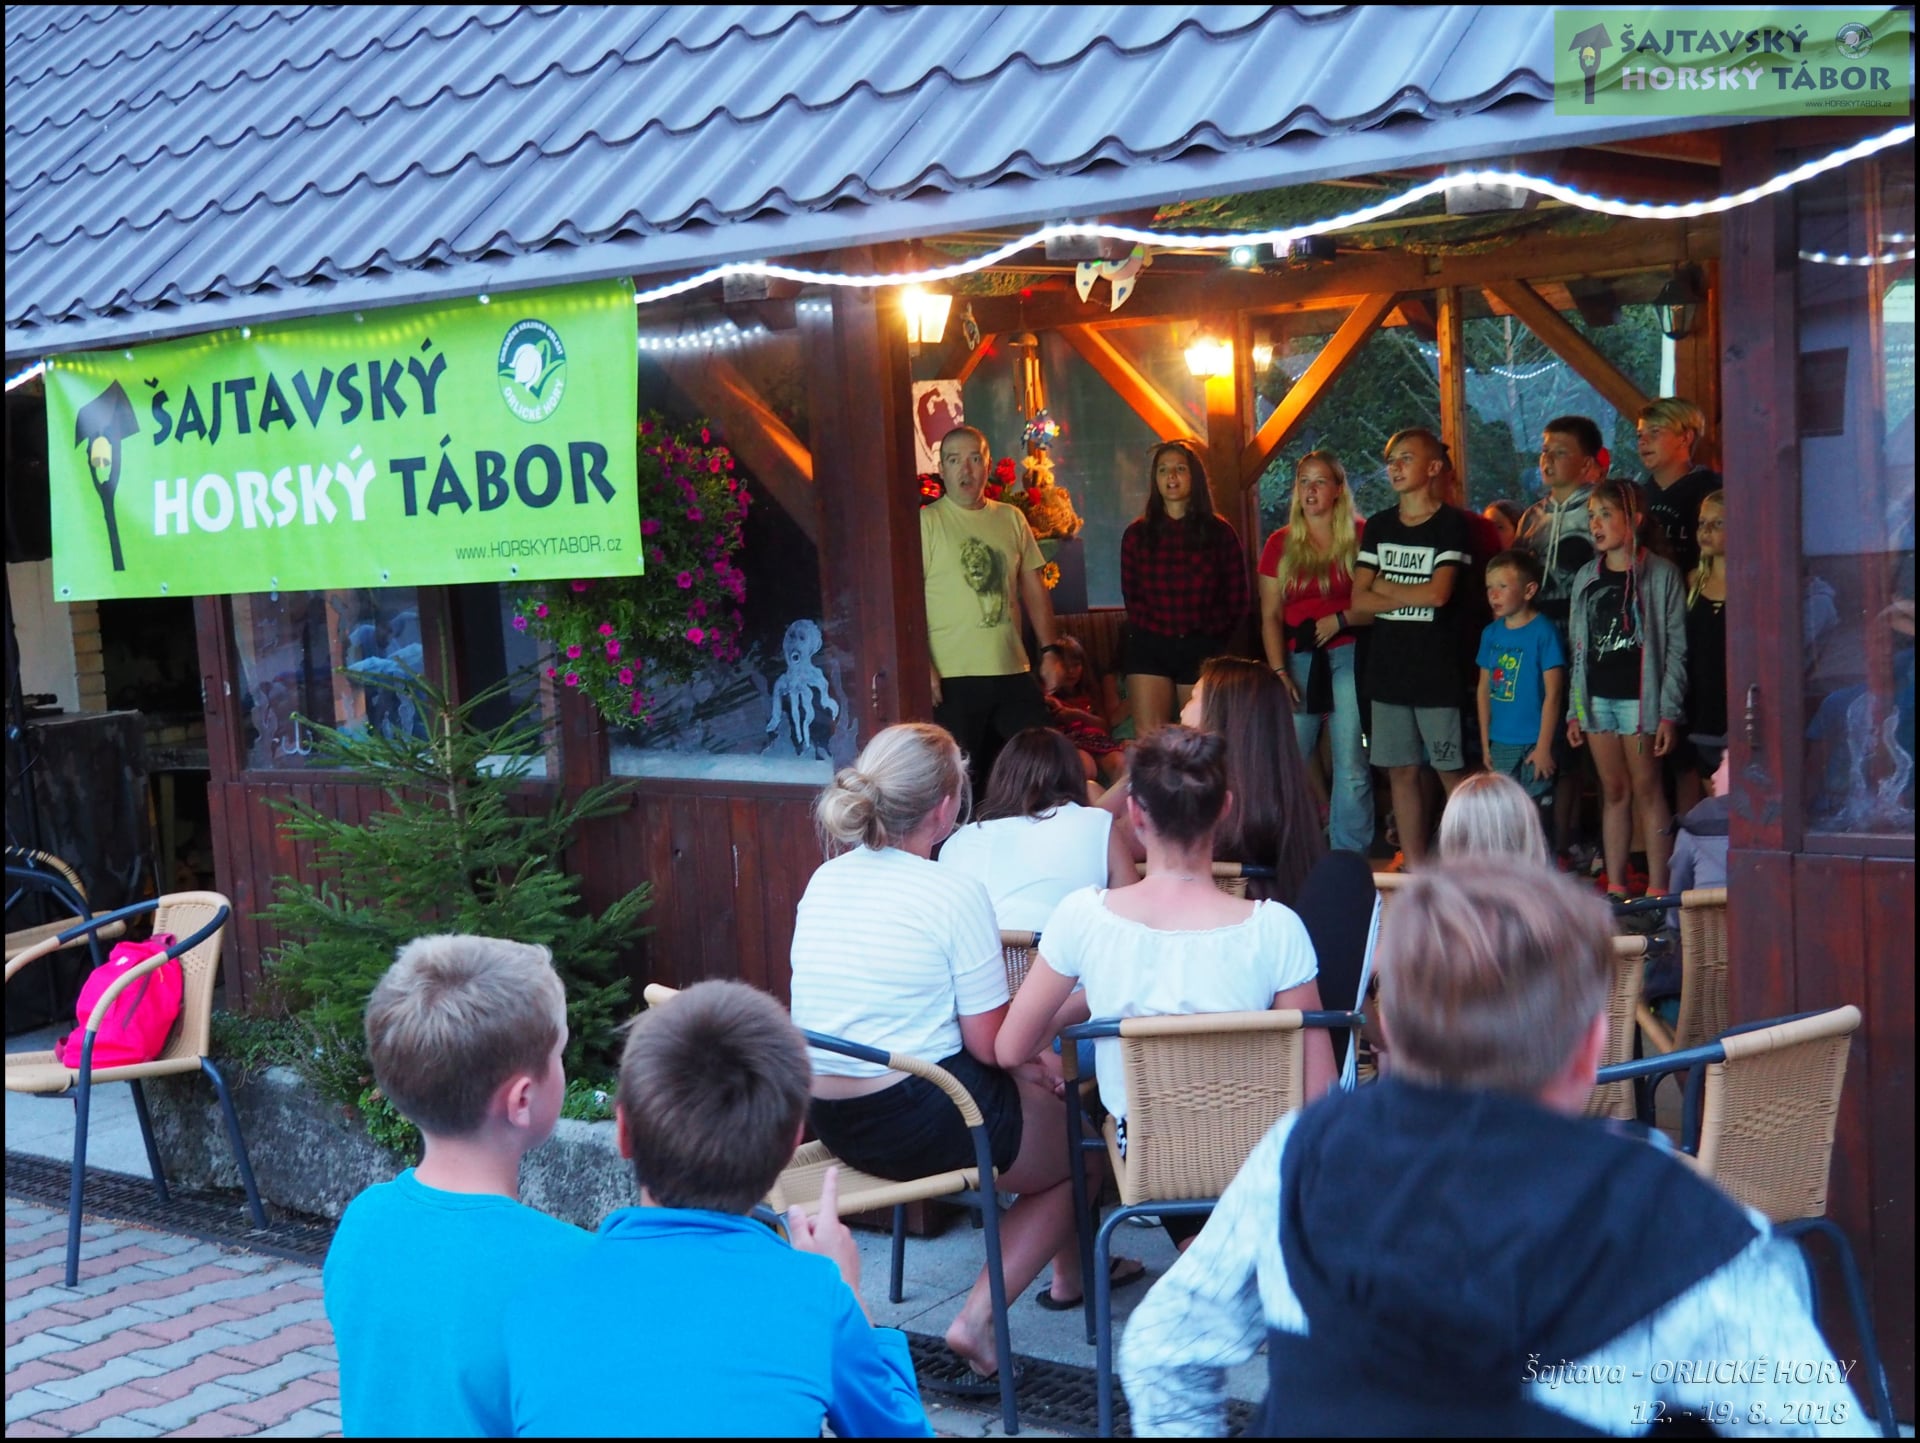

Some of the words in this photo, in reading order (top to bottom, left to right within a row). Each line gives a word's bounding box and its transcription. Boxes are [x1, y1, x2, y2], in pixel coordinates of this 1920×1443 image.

[144, 337, 446, 445] ŠAJTAVSKÝ
[153, 444, 376, 536] HORSKÝ
[390, 434, 616, 517] TÁBOR
[455, 535, 622, 559] www.HORSKYTABOR.cz
